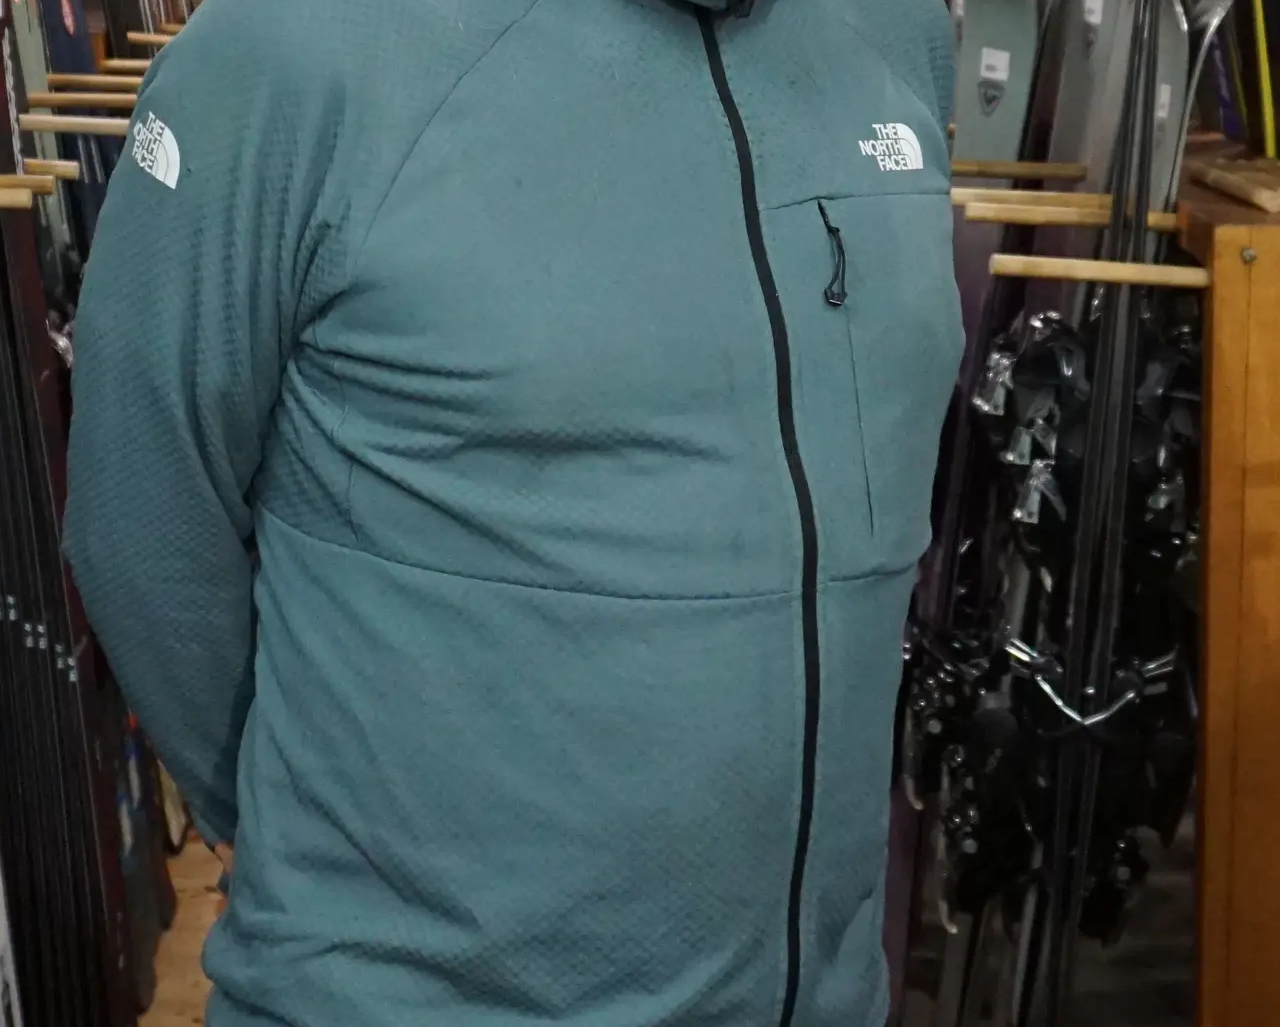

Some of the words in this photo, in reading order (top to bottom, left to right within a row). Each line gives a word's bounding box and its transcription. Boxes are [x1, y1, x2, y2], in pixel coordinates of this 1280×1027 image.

[146, 110, 166, 141] THE
[871, 122, 899, 140] THE
[132, 120, 161, 157] ORTH
[858, 139, 903, 156] NORTH
[131, 140, 156, 174] FACE
[876, 155, 909, 171] FACE
